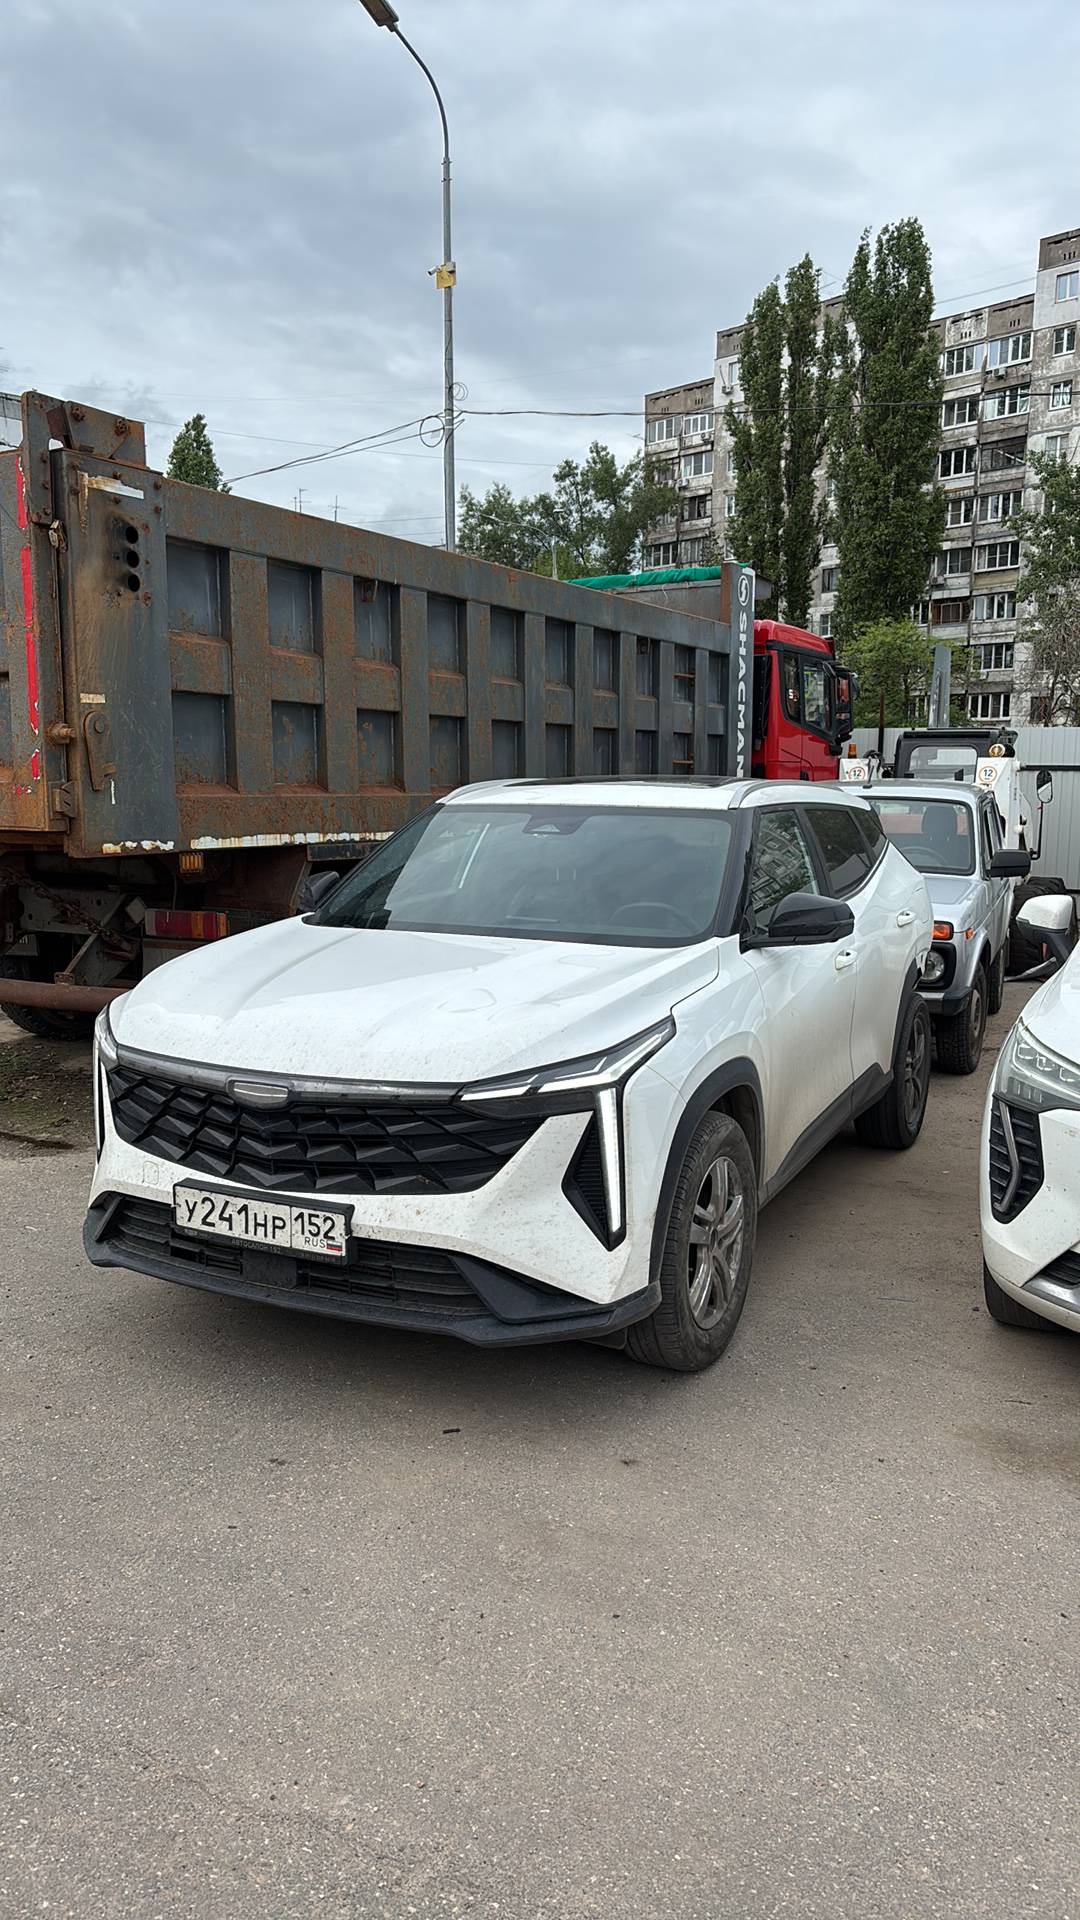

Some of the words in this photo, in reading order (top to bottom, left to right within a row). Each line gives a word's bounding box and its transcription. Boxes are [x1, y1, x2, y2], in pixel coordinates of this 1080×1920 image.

[736, 611, 747, 778] SHACMAN
[983, 769, 994, 777] 12
[294, 1212, 336, 1241] 152
[305, 1236, 326, 1249] RUS
